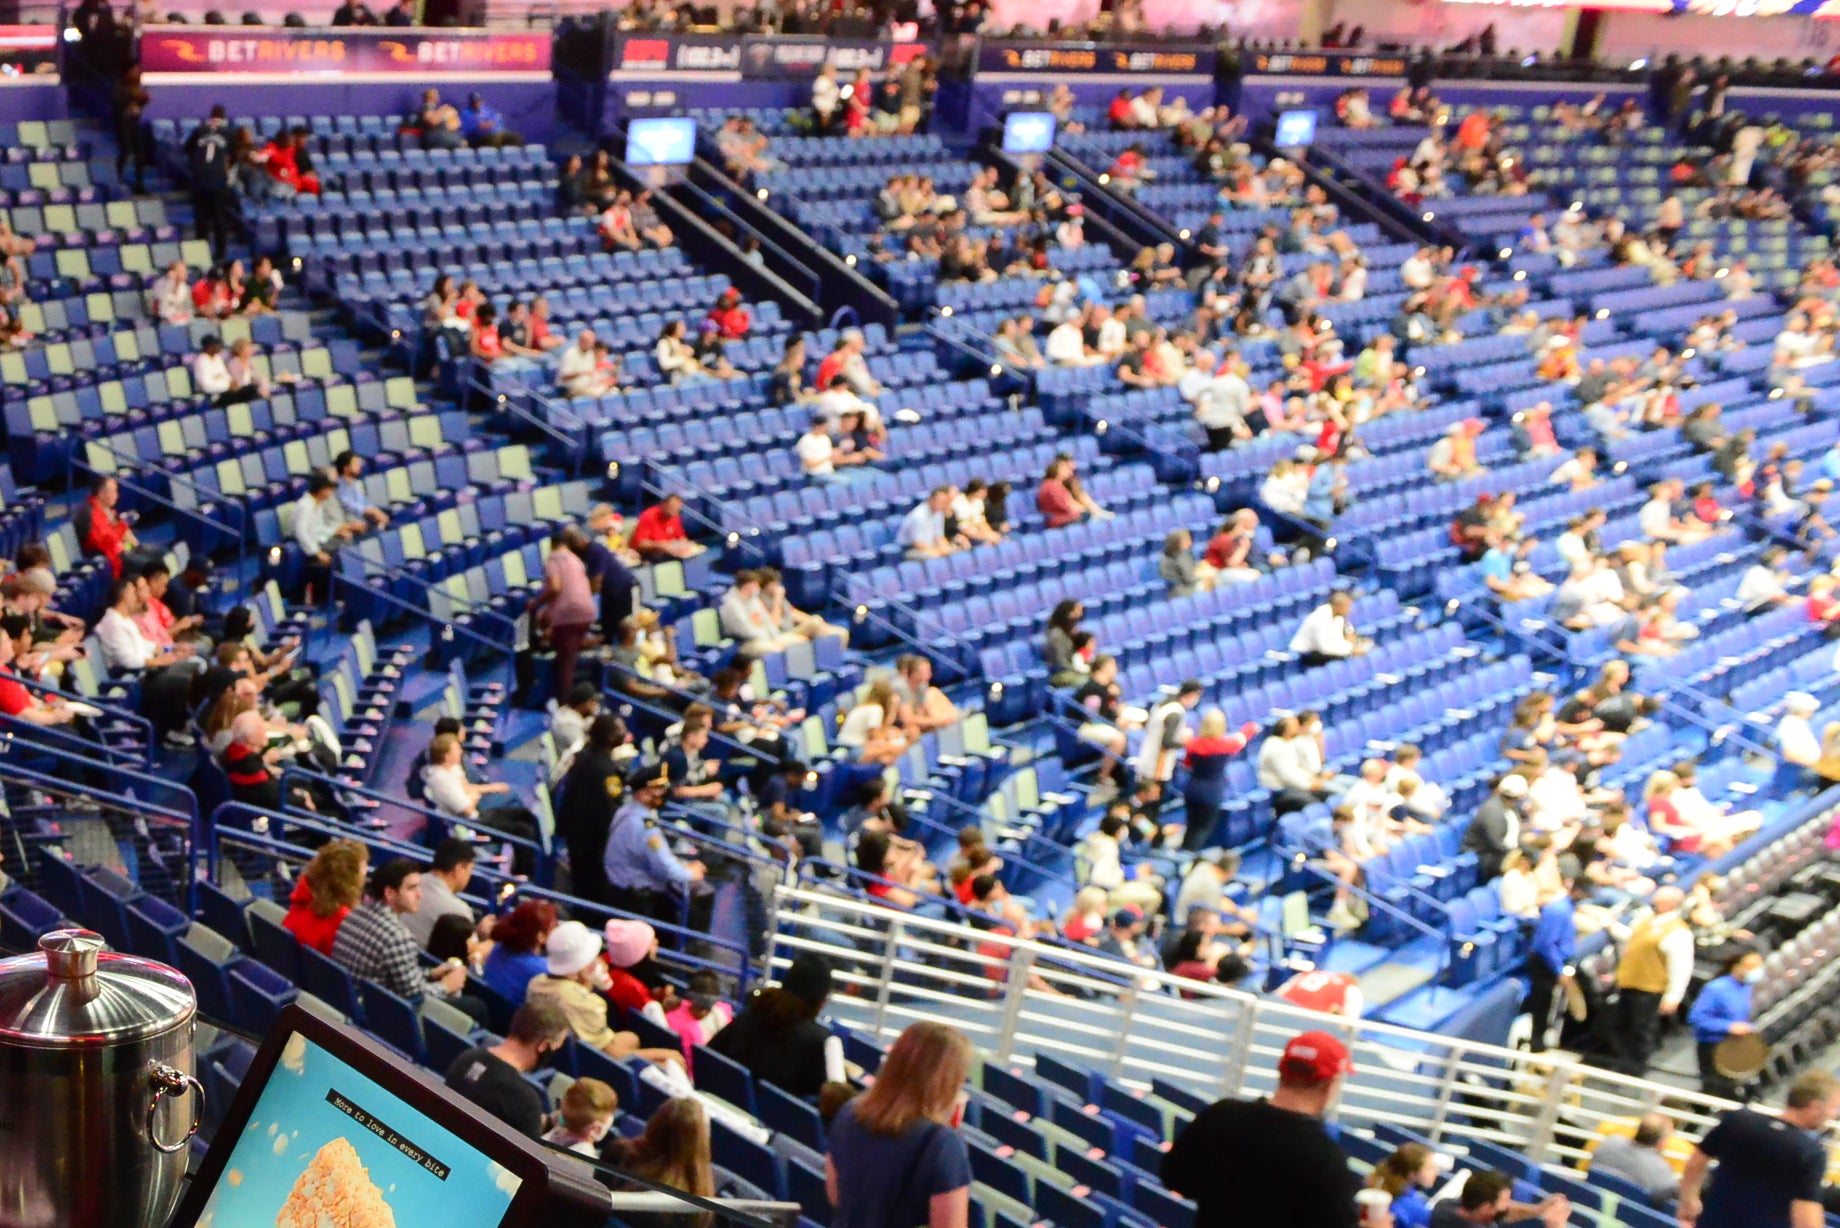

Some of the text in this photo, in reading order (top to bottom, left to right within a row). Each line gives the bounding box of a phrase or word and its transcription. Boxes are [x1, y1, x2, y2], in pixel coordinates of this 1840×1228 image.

[334, 1098, 445, 1177] More to love in every bite
